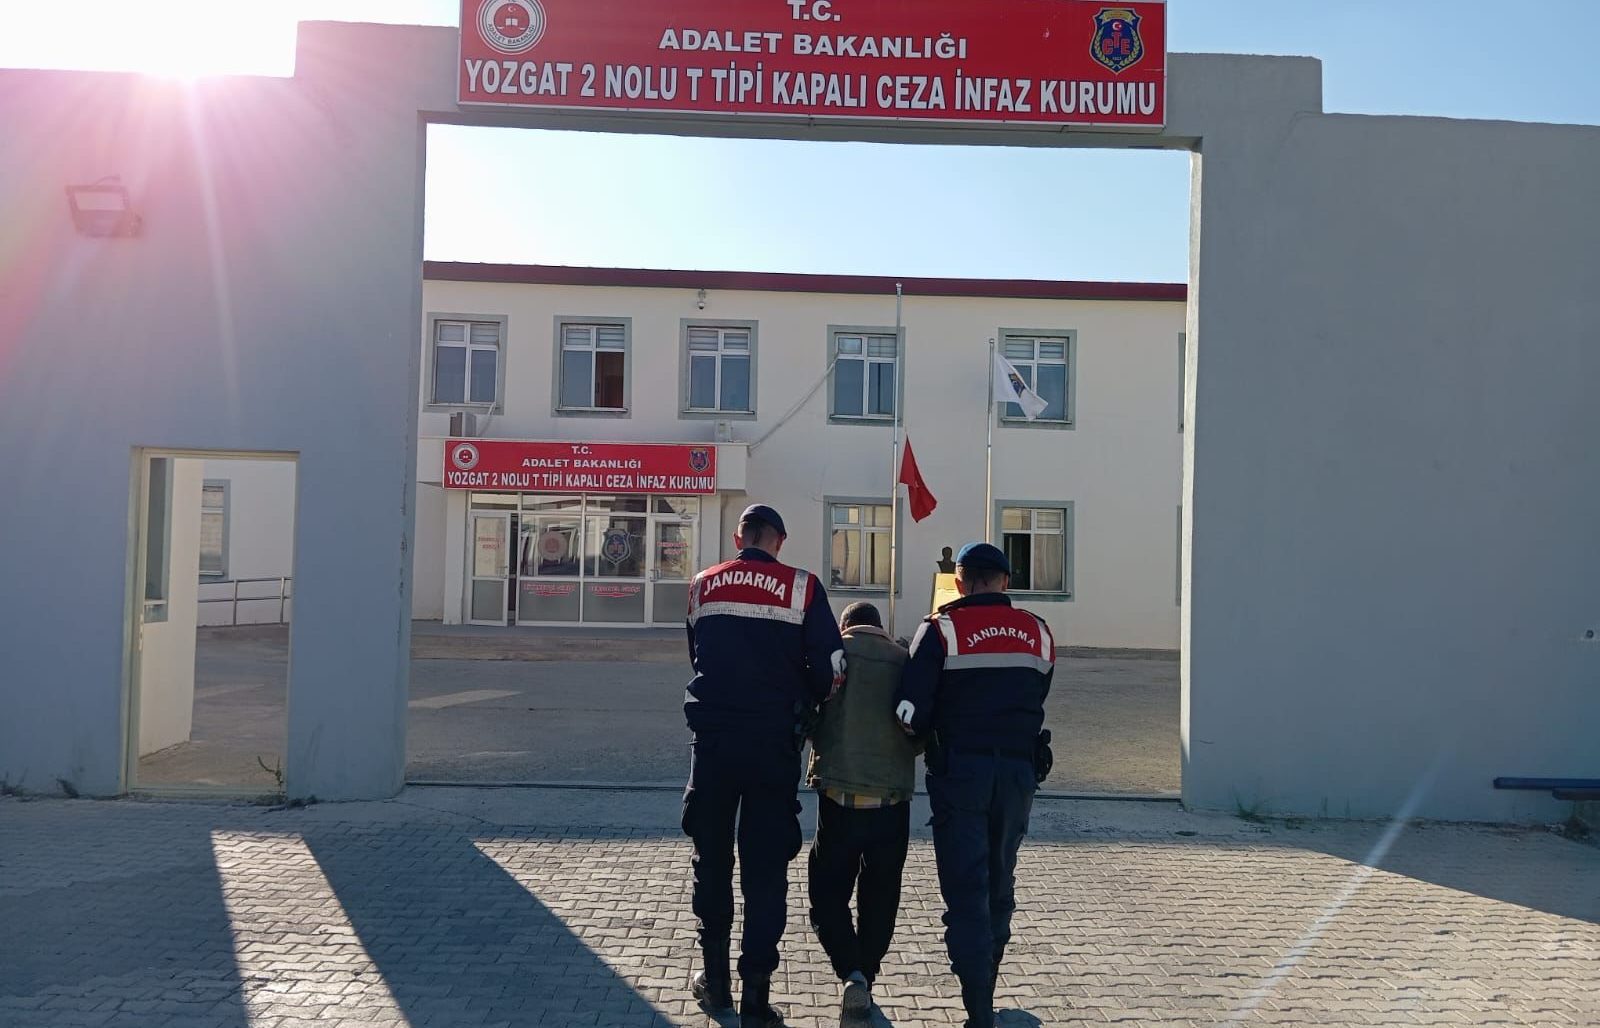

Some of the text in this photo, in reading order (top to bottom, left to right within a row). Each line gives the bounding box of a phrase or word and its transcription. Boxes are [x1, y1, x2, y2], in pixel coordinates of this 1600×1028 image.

[787, 0, 841, 21] T.C.
[658, 28, 967, 59] ADALET BAKANLIĞI
[464, 59, 1156, 116] YOZGAT 2 NOLU T TİPİ KAPALI CEZA İNFAZ KURUMU
[571, 445, 593, 455] T.C.
[521, 458, 642, 469] ADALET BAKANLIĞI
[447, 470, 714, 490] YOZGAT 2 NOLU T TİPİ KAPALI CEZA İNFAZ KURUMU
[703, 571, 787, 601] JANDARMA
[966, 627, 1036, 649] JANDARMA
